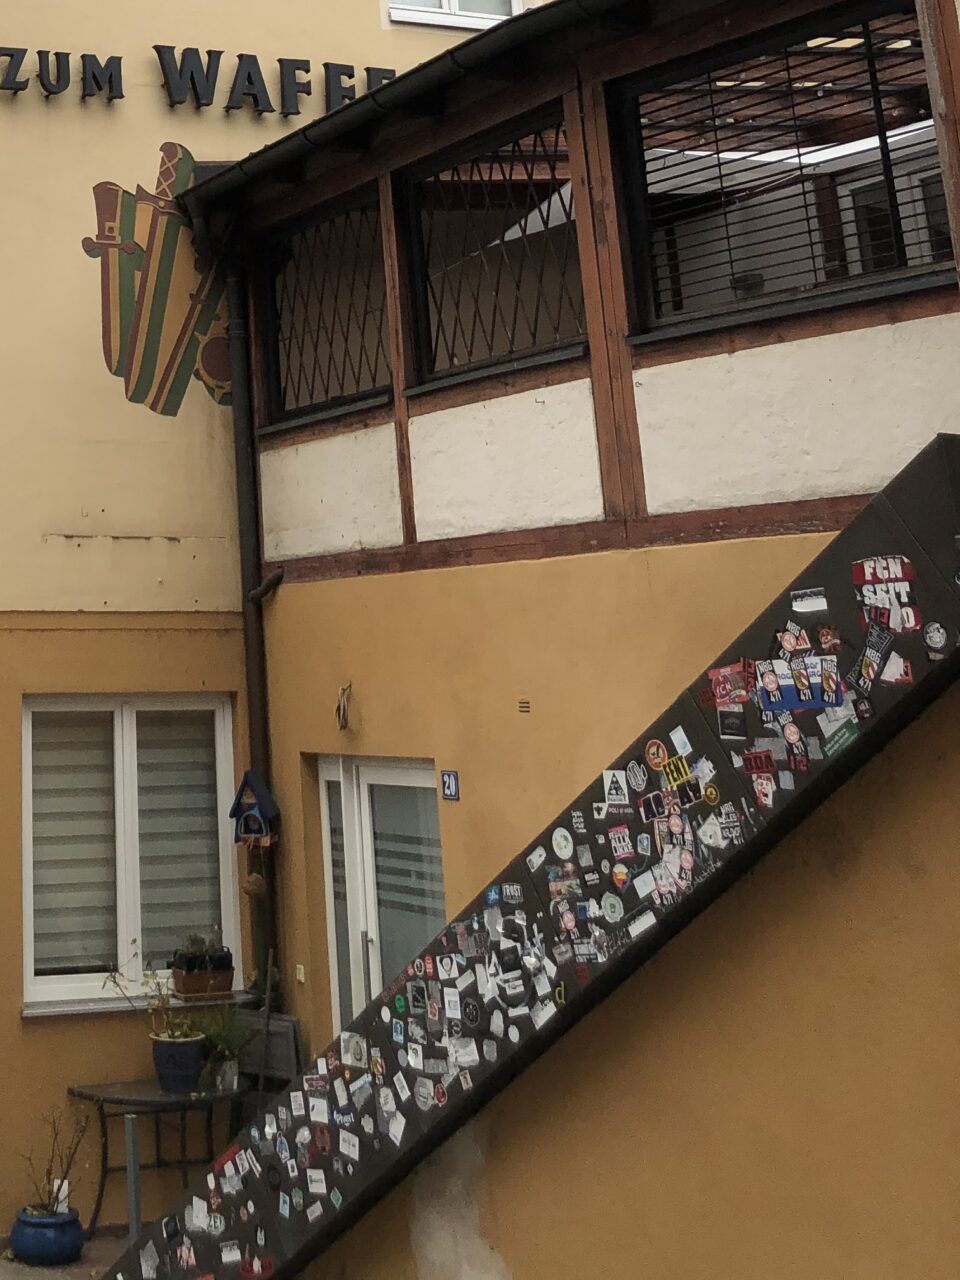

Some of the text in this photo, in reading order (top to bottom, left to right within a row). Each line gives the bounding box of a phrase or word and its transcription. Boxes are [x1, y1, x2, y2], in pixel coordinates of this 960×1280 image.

[863, 557, 903, 580] FCN
[785, 619, 801, 636] NBG
[865, 646, 882, 664] NBG
[759, 660, 773, 674] NBG
[790, 658, 805, 671] NBG
[822, 660, 837, 673] NBG
[858, 676, 872, 692] 471
[770, 691, 782, 703] 471
[800, 689, 812, 701] 471
[823, 691, 836, 704] 471
[443, 774, 456, 796] 20
